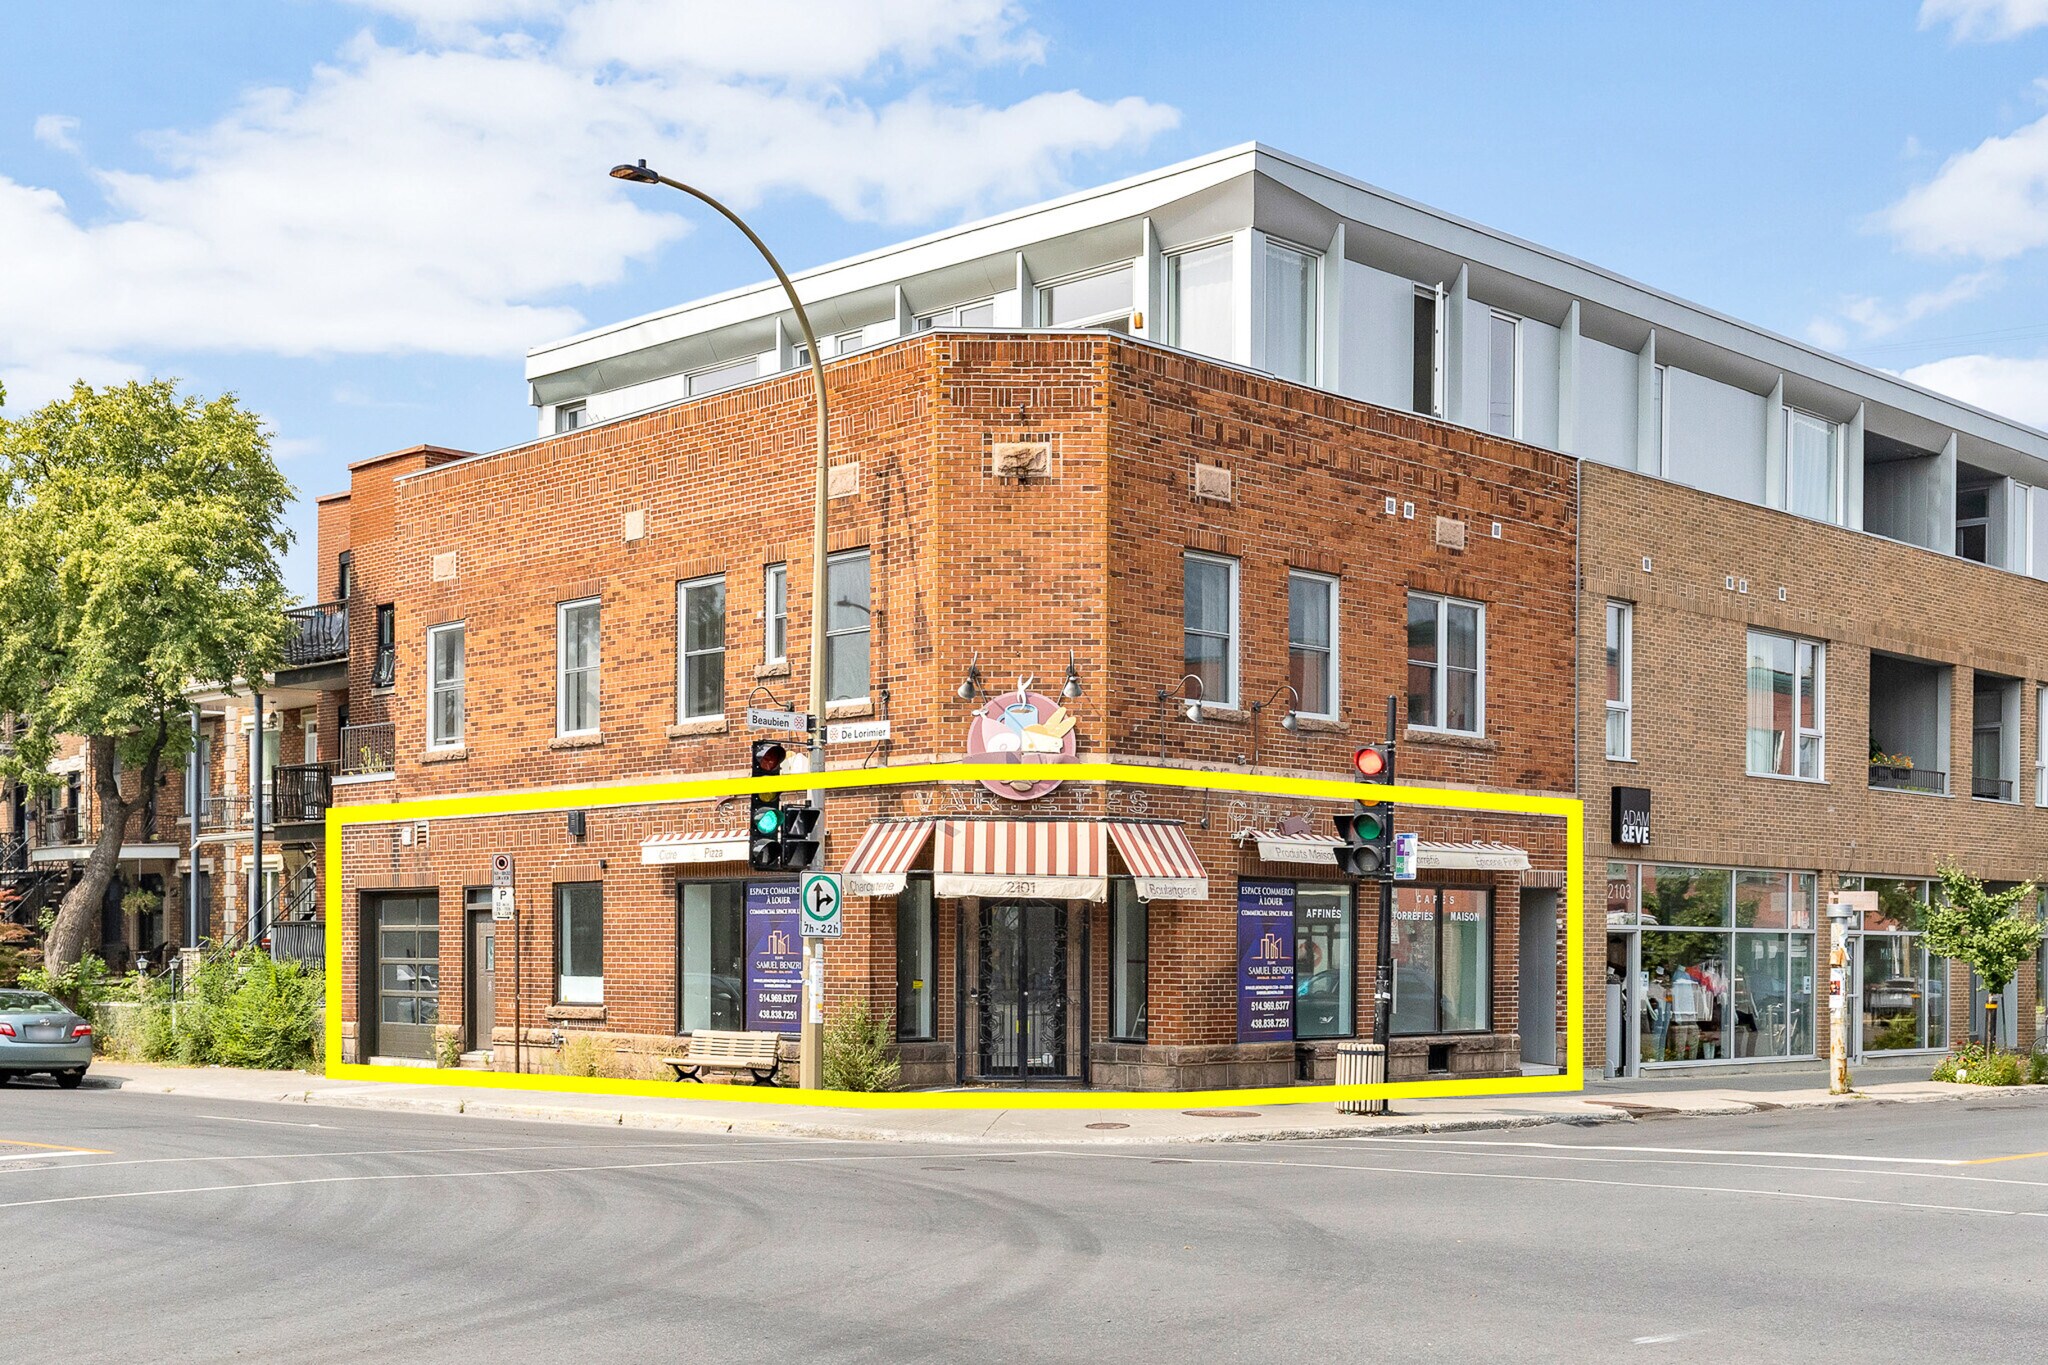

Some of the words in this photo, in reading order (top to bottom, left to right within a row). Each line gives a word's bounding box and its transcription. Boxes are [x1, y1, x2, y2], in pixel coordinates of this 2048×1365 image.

[752, 715, 790, 727] Beaubien
[841, 730, 852, 739] De
[854, 728, 886, 739] Lorimier
[1622, 810, 1649, 826] ADAM
[1621, 824, 1649, 844] &EVE
[704, 847, 723, 858] Pizza
[1275, 847, 1308, 859] Produits
[1416, 854, 1440, 865] orréfié
[749, 887, 769, 895] ESPACE
[769, 886, 800, 895] COMMERC
[850, 880, 894, 893] Charcuterie
[1007, 881, 1036, 893] 2101
[1149, 883, 1198, 898] Boulangerie
[1241, 887, 1261, 895] ESPACE
[1607, 883, 1632, 900] 2103
[500, 890, 507, 900] P
[766, 895, 772, 904] À
[772, 896, 792, 904] LOUER
[1258, 895, 1264, 906] À
[1264, 897, 1284, 906] LOUER
[1306, 906, 1342, 918] AFFINÉS
[1393, 908, 1434, 921] TORRÉFIÉS
[1450, 911, 1480, 921] MAISON
[756, 961, 779, 969] SAMUEL
[779, 961, 802, 969] BENIZRI
[1248, 966, 1272, 975] SAMUEL
[758, 993, 798, 1003] 514.969.6377
[1250, 1001, 1290, 1011] 514.969.6377
[758, 1009, 798, 1020] 438.838.7251
[1250, 1017, 1290, 1029] 438.838.7251
